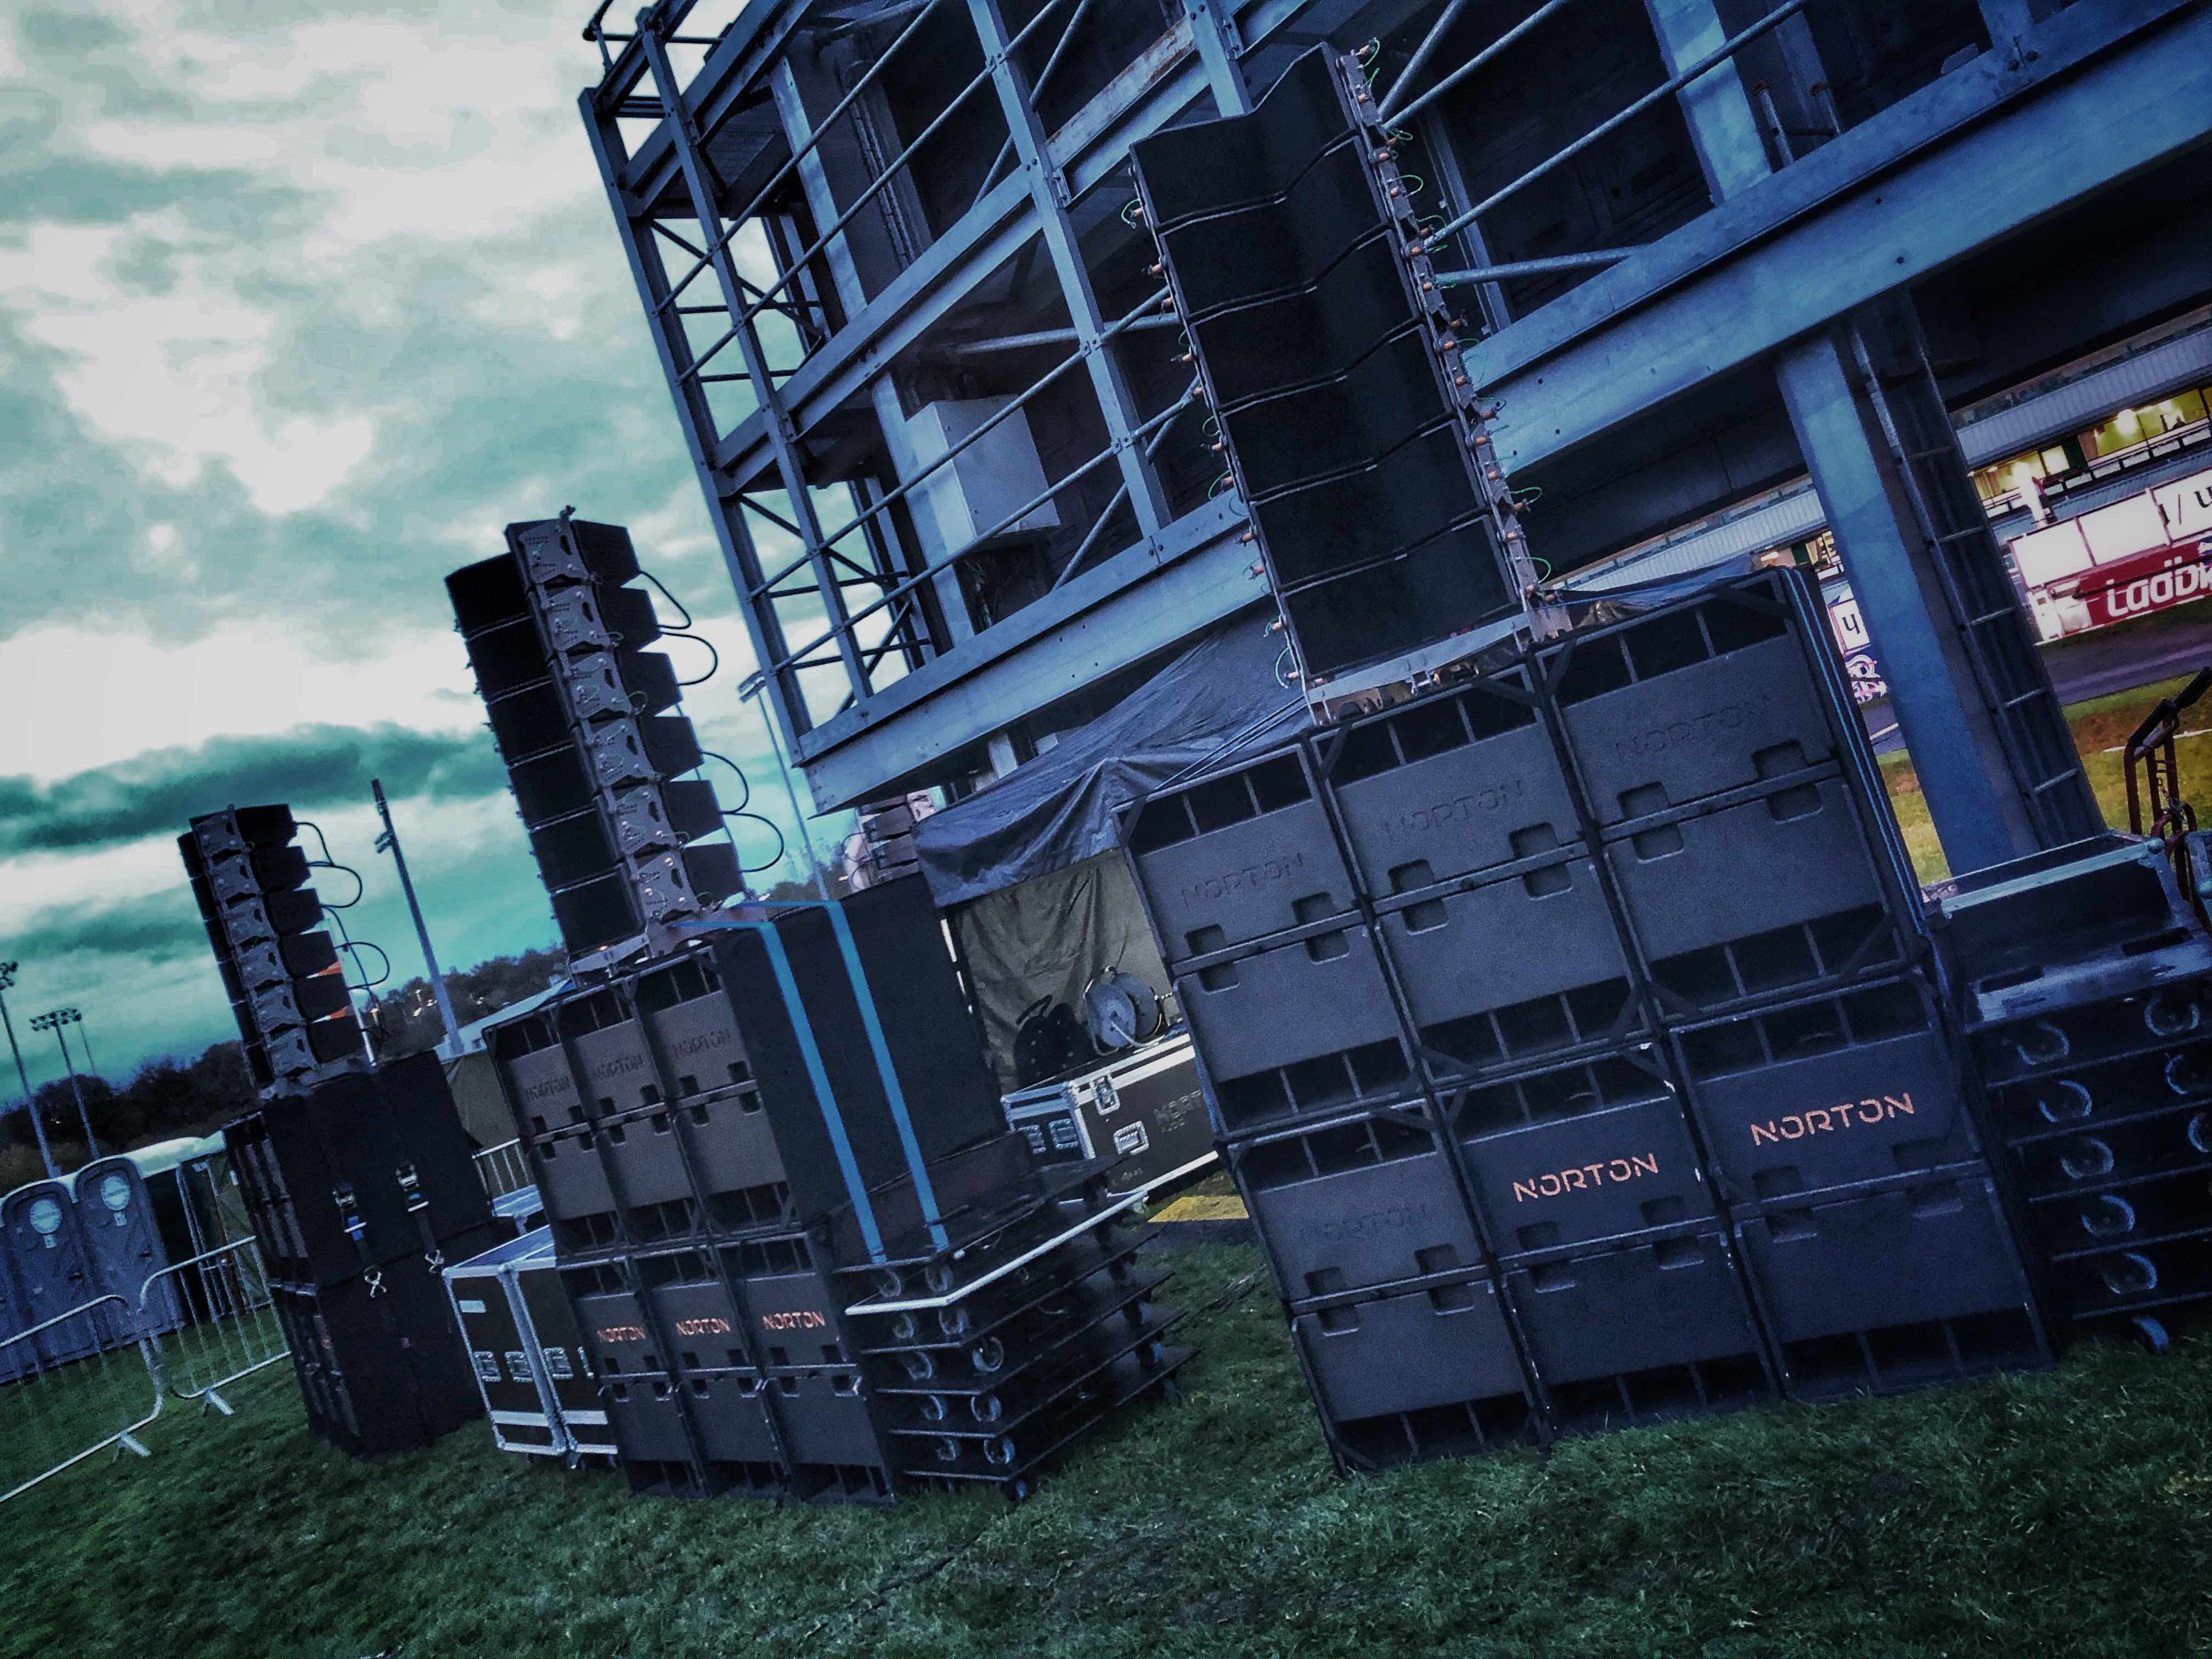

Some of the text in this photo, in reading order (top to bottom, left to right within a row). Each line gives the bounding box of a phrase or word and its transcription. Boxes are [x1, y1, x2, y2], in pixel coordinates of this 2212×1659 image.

[1615, 693, 1770, 760] NORTON
[1384, 778, 1523, 840] NORTON
[1181, 852, 1304, 907] NORTON
[674, 1028, 731, 1059] NORTON
[1750, 1092, 1915, 1146] NORTON
[1511, 1152, 1660, 1203] NORTON
[596, 1326, 647, 1343] NORTON
[675, 1317, 731, 1336] NORTON
[762, 1311, 826, 1330] NORTON
